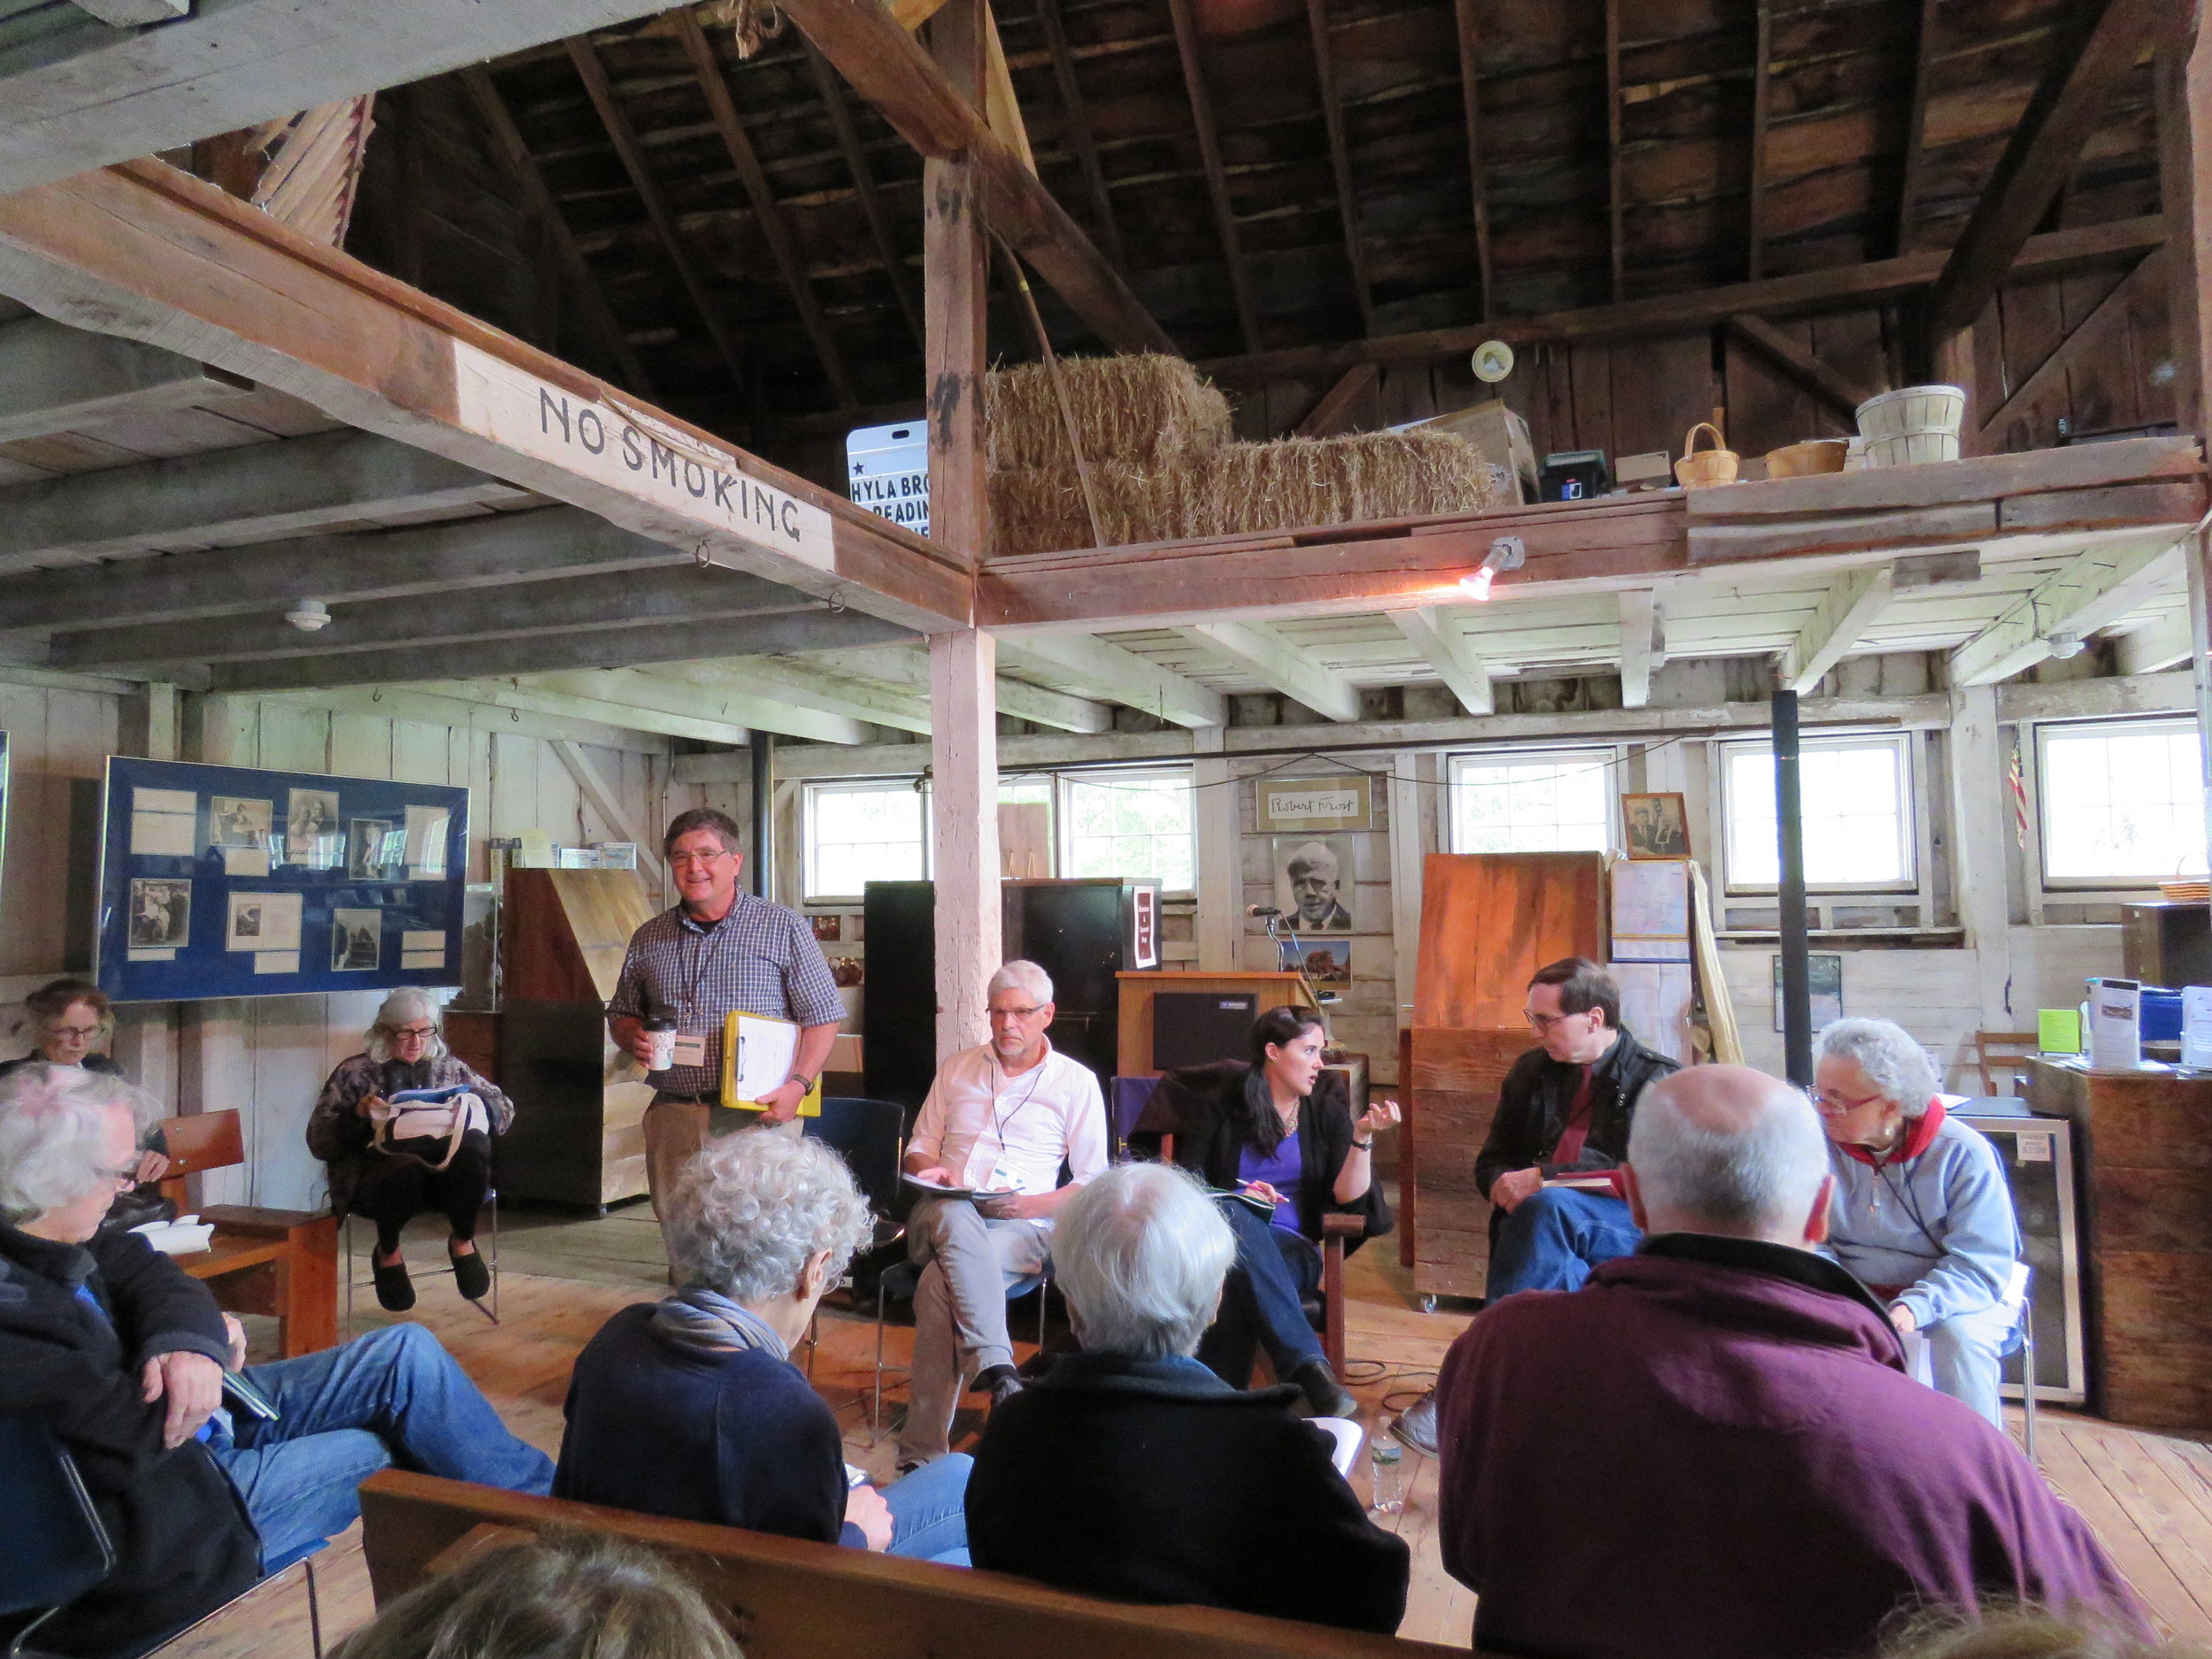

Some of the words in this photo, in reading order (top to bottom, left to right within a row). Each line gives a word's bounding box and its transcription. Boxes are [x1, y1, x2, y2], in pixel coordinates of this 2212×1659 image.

[540, 387, 605, 455] NO
[622, 426, 801, 542] SMOKING
[851, 480, 896, 503] HYLA
[1271, 798, 1315, 813] Robert
[1318, 796, 1355, 812] Frost
